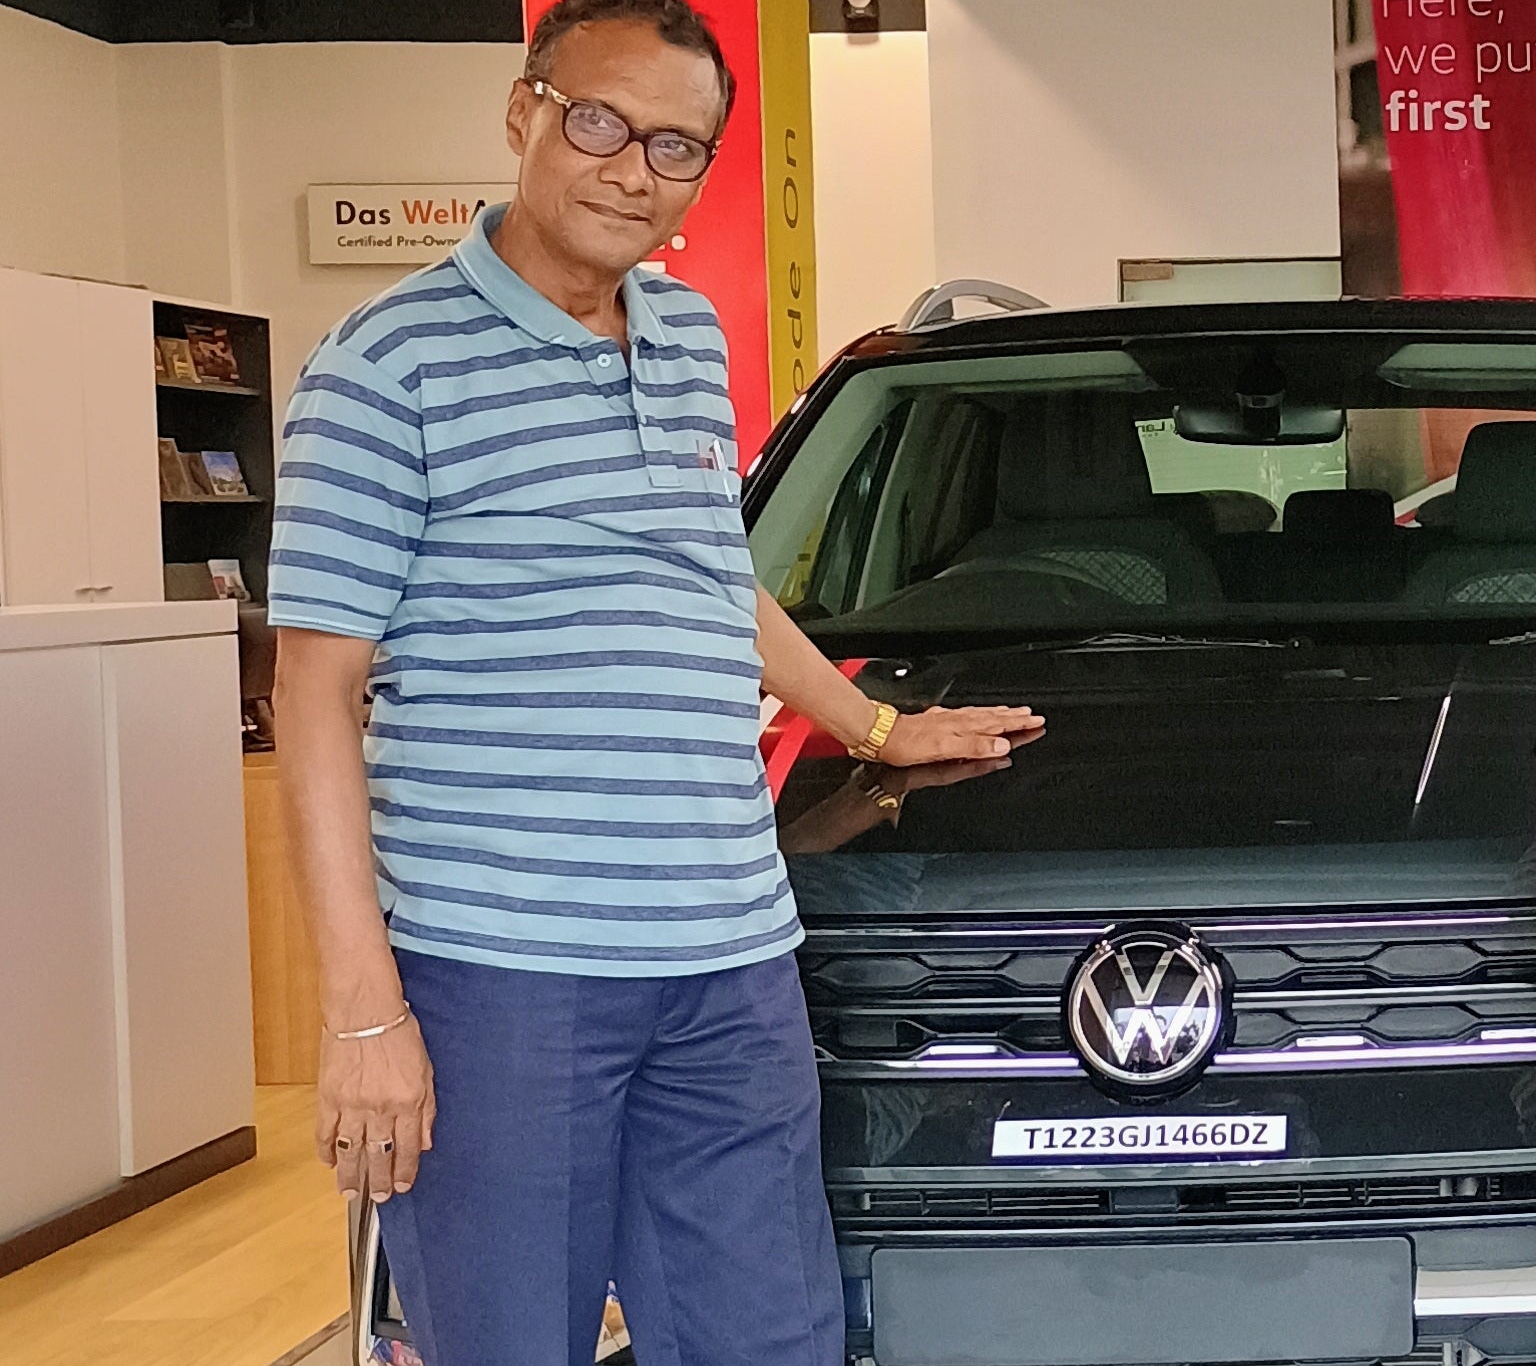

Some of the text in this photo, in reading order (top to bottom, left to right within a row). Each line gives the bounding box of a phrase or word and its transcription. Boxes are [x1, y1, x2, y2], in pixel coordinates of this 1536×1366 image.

[1384, 41, 1456, 75] we
[1385, 89, 1491, 132] first
[783, 128, 798, 229] On
[335, 200, 391, 225] Das
[337, 235, 393, 247] Certified
[1024, 1123, 1269, 1149] T1223GJ1466DZ
